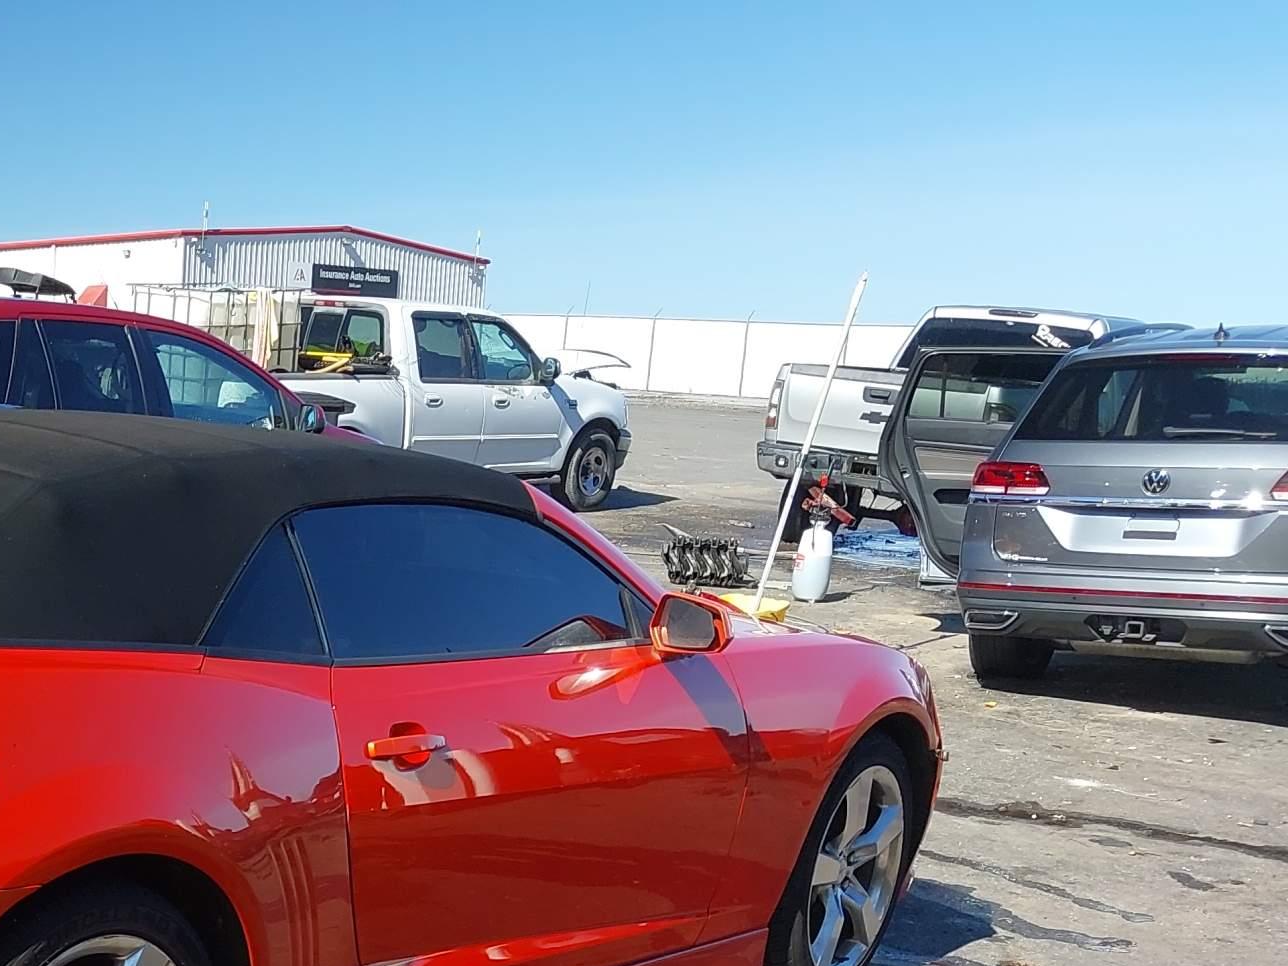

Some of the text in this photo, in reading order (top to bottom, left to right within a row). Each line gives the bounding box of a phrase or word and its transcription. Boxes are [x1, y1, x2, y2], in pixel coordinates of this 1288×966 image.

[319, 268, 391, 283] Insurance Auto Auctions
